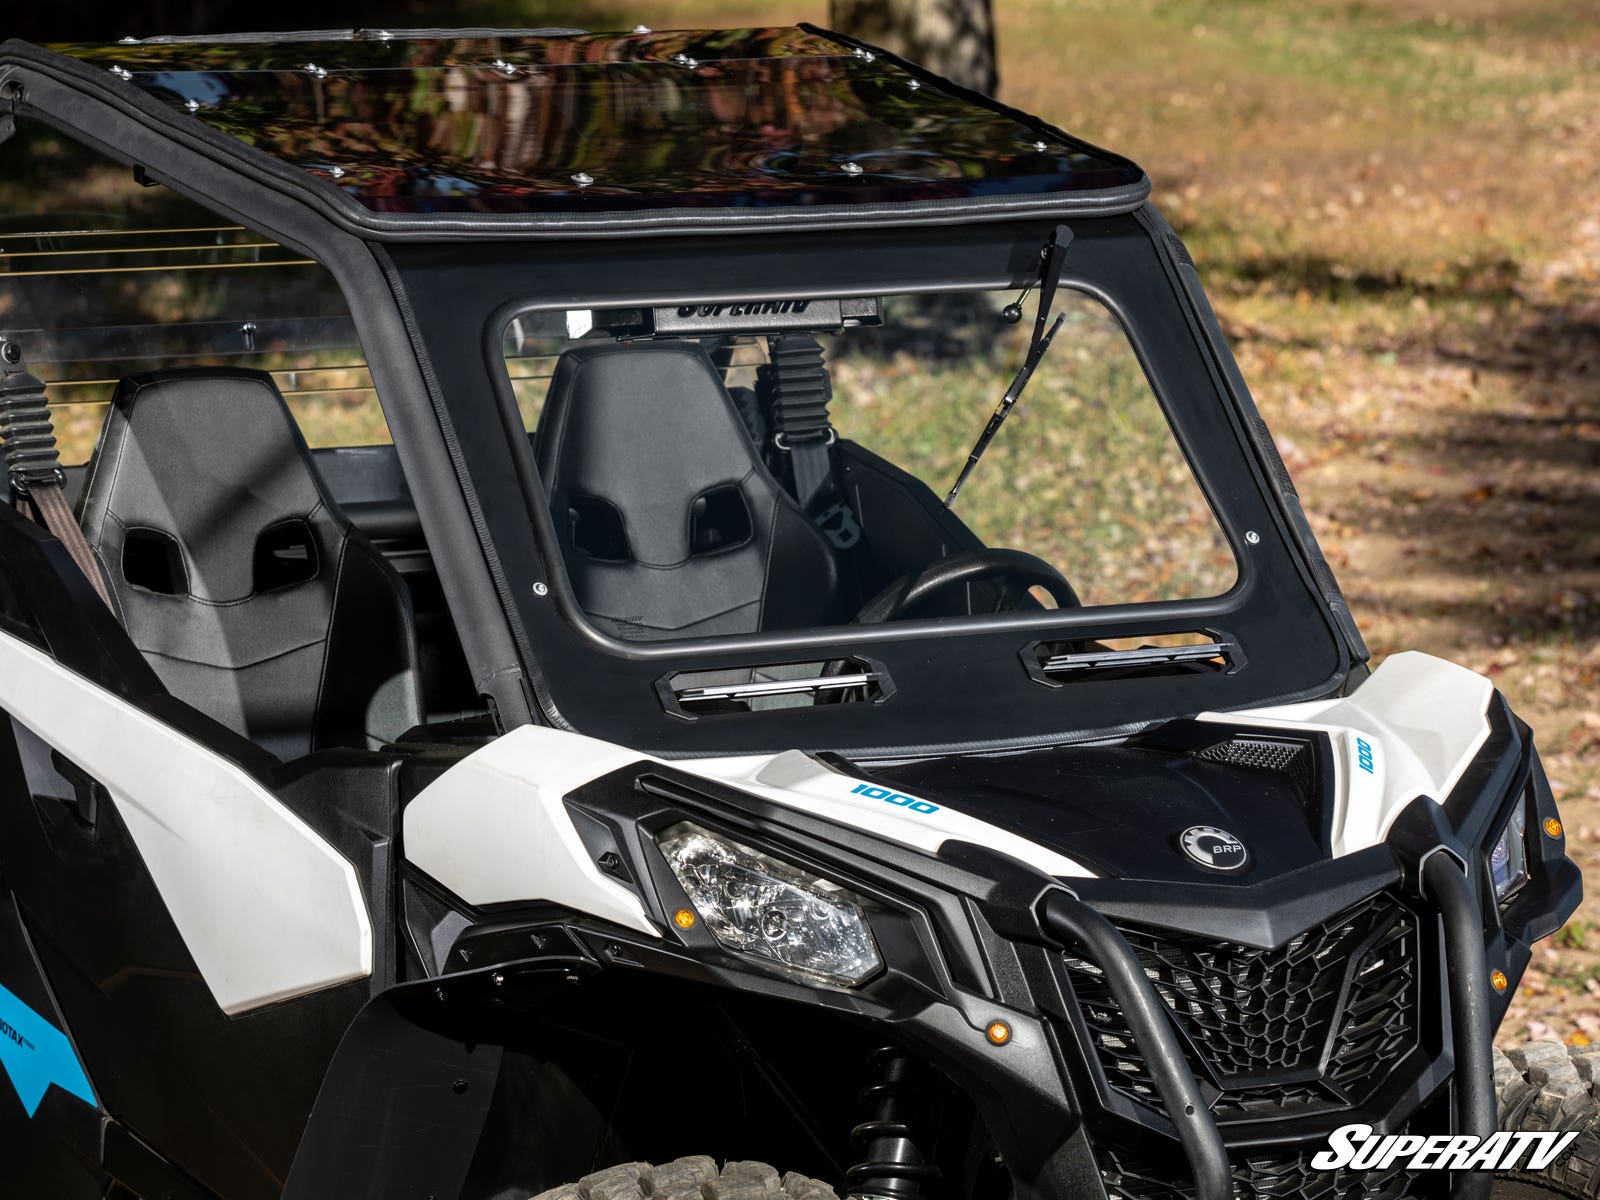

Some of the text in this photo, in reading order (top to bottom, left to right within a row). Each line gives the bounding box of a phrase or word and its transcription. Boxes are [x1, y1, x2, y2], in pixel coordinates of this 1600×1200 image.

[1356, 737, 1374, 775] 1000
[850, 784, 940, 815] 1000
[1212, 845, 1242, 854] BRP
